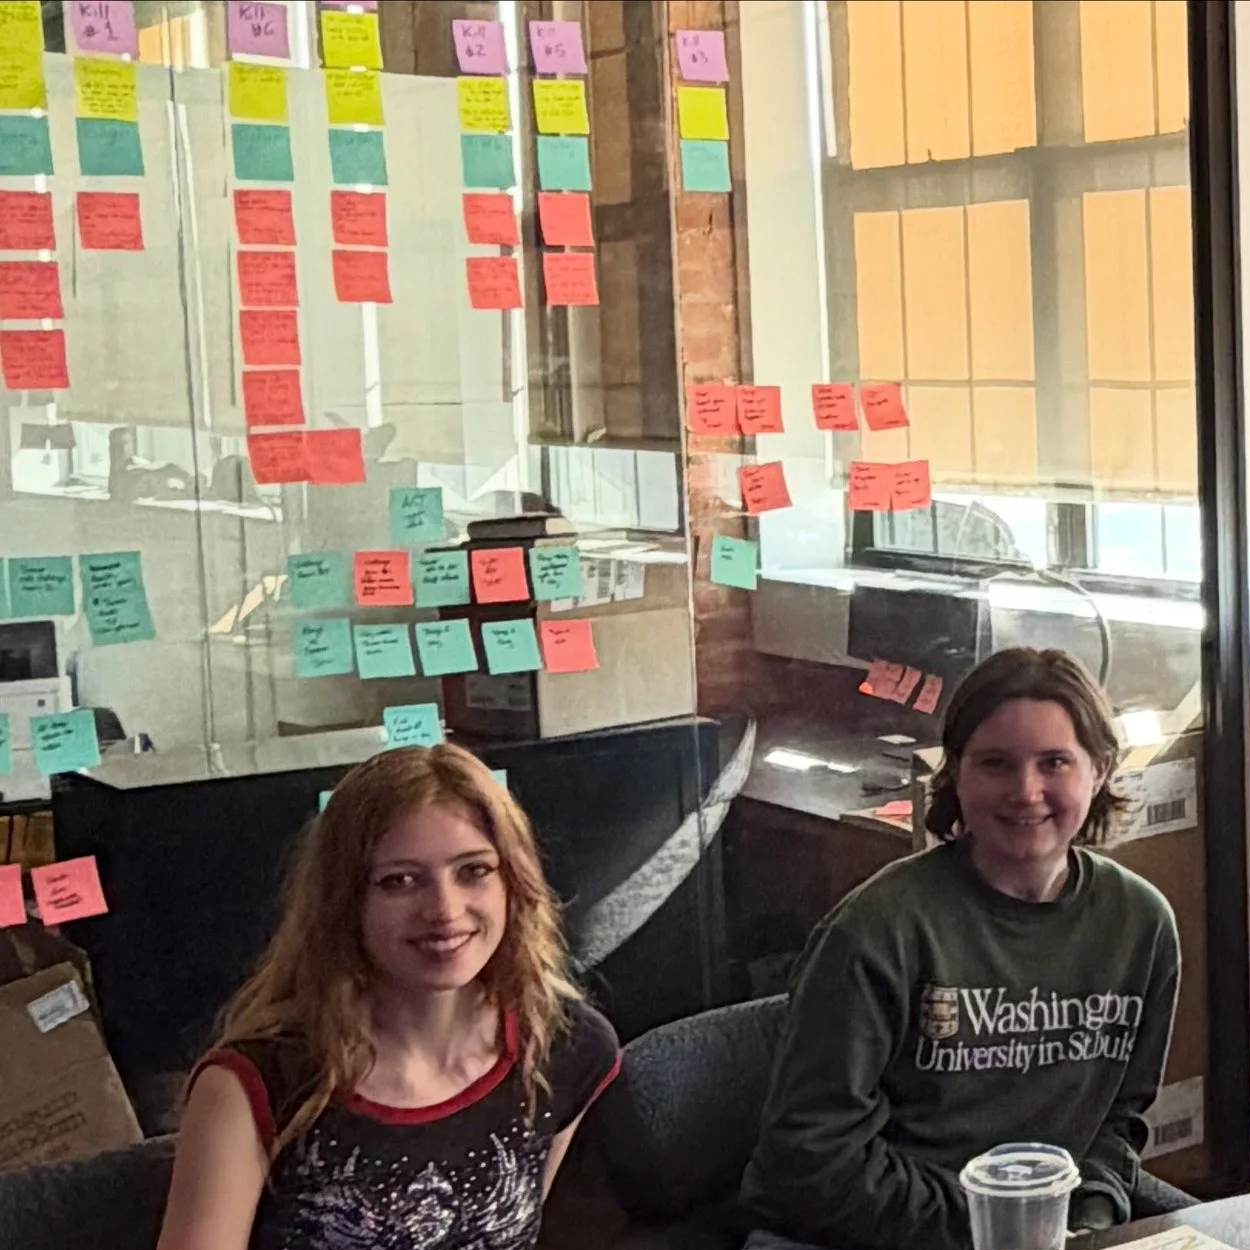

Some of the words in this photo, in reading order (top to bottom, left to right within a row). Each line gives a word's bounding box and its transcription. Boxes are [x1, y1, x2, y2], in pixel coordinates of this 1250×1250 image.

[960, 986, 1143, 1035] Washington
[915, 1037, 1036, 1073] University
[1038, 1036, 1064, 1066] in
